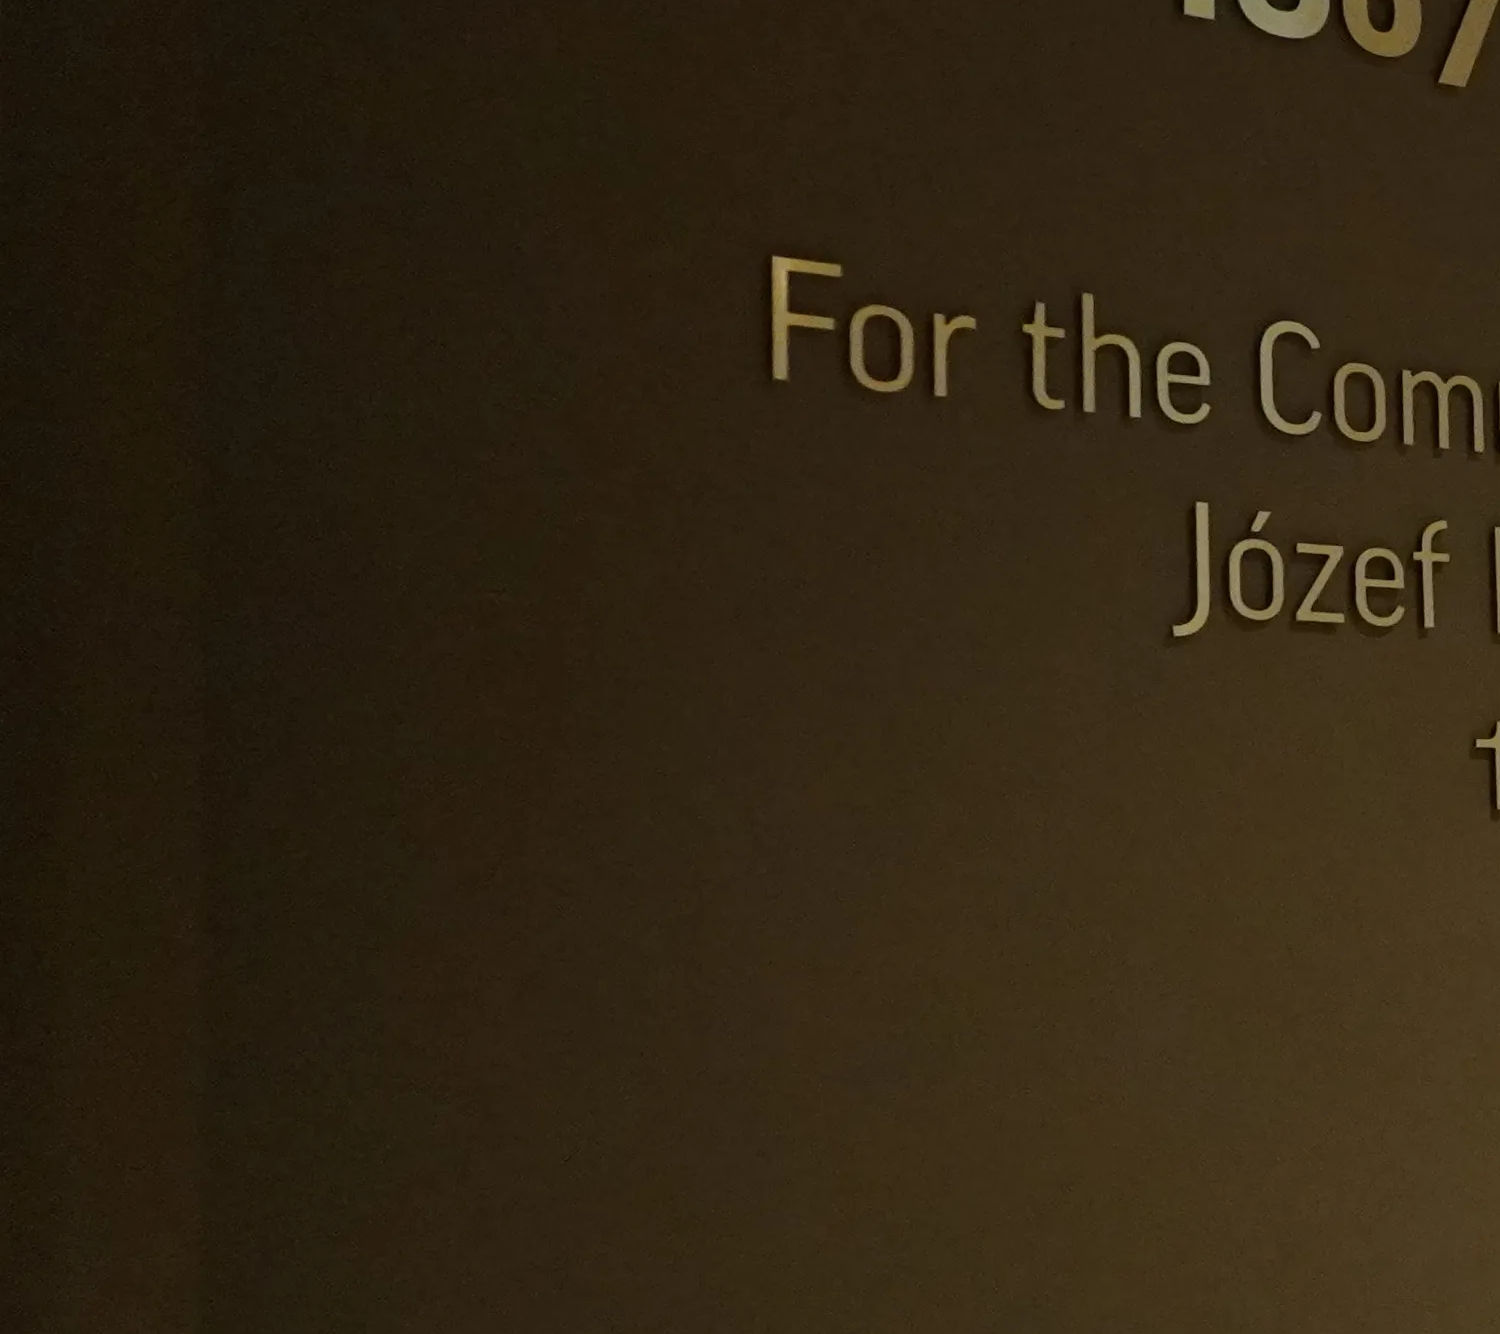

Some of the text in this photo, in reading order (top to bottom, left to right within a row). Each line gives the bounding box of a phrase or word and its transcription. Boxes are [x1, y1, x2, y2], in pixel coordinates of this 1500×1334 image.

[769, 255, 976, 397] For
[1022, 293, 1211, 424] the
[1172, 501, 1450, 637] Józef
